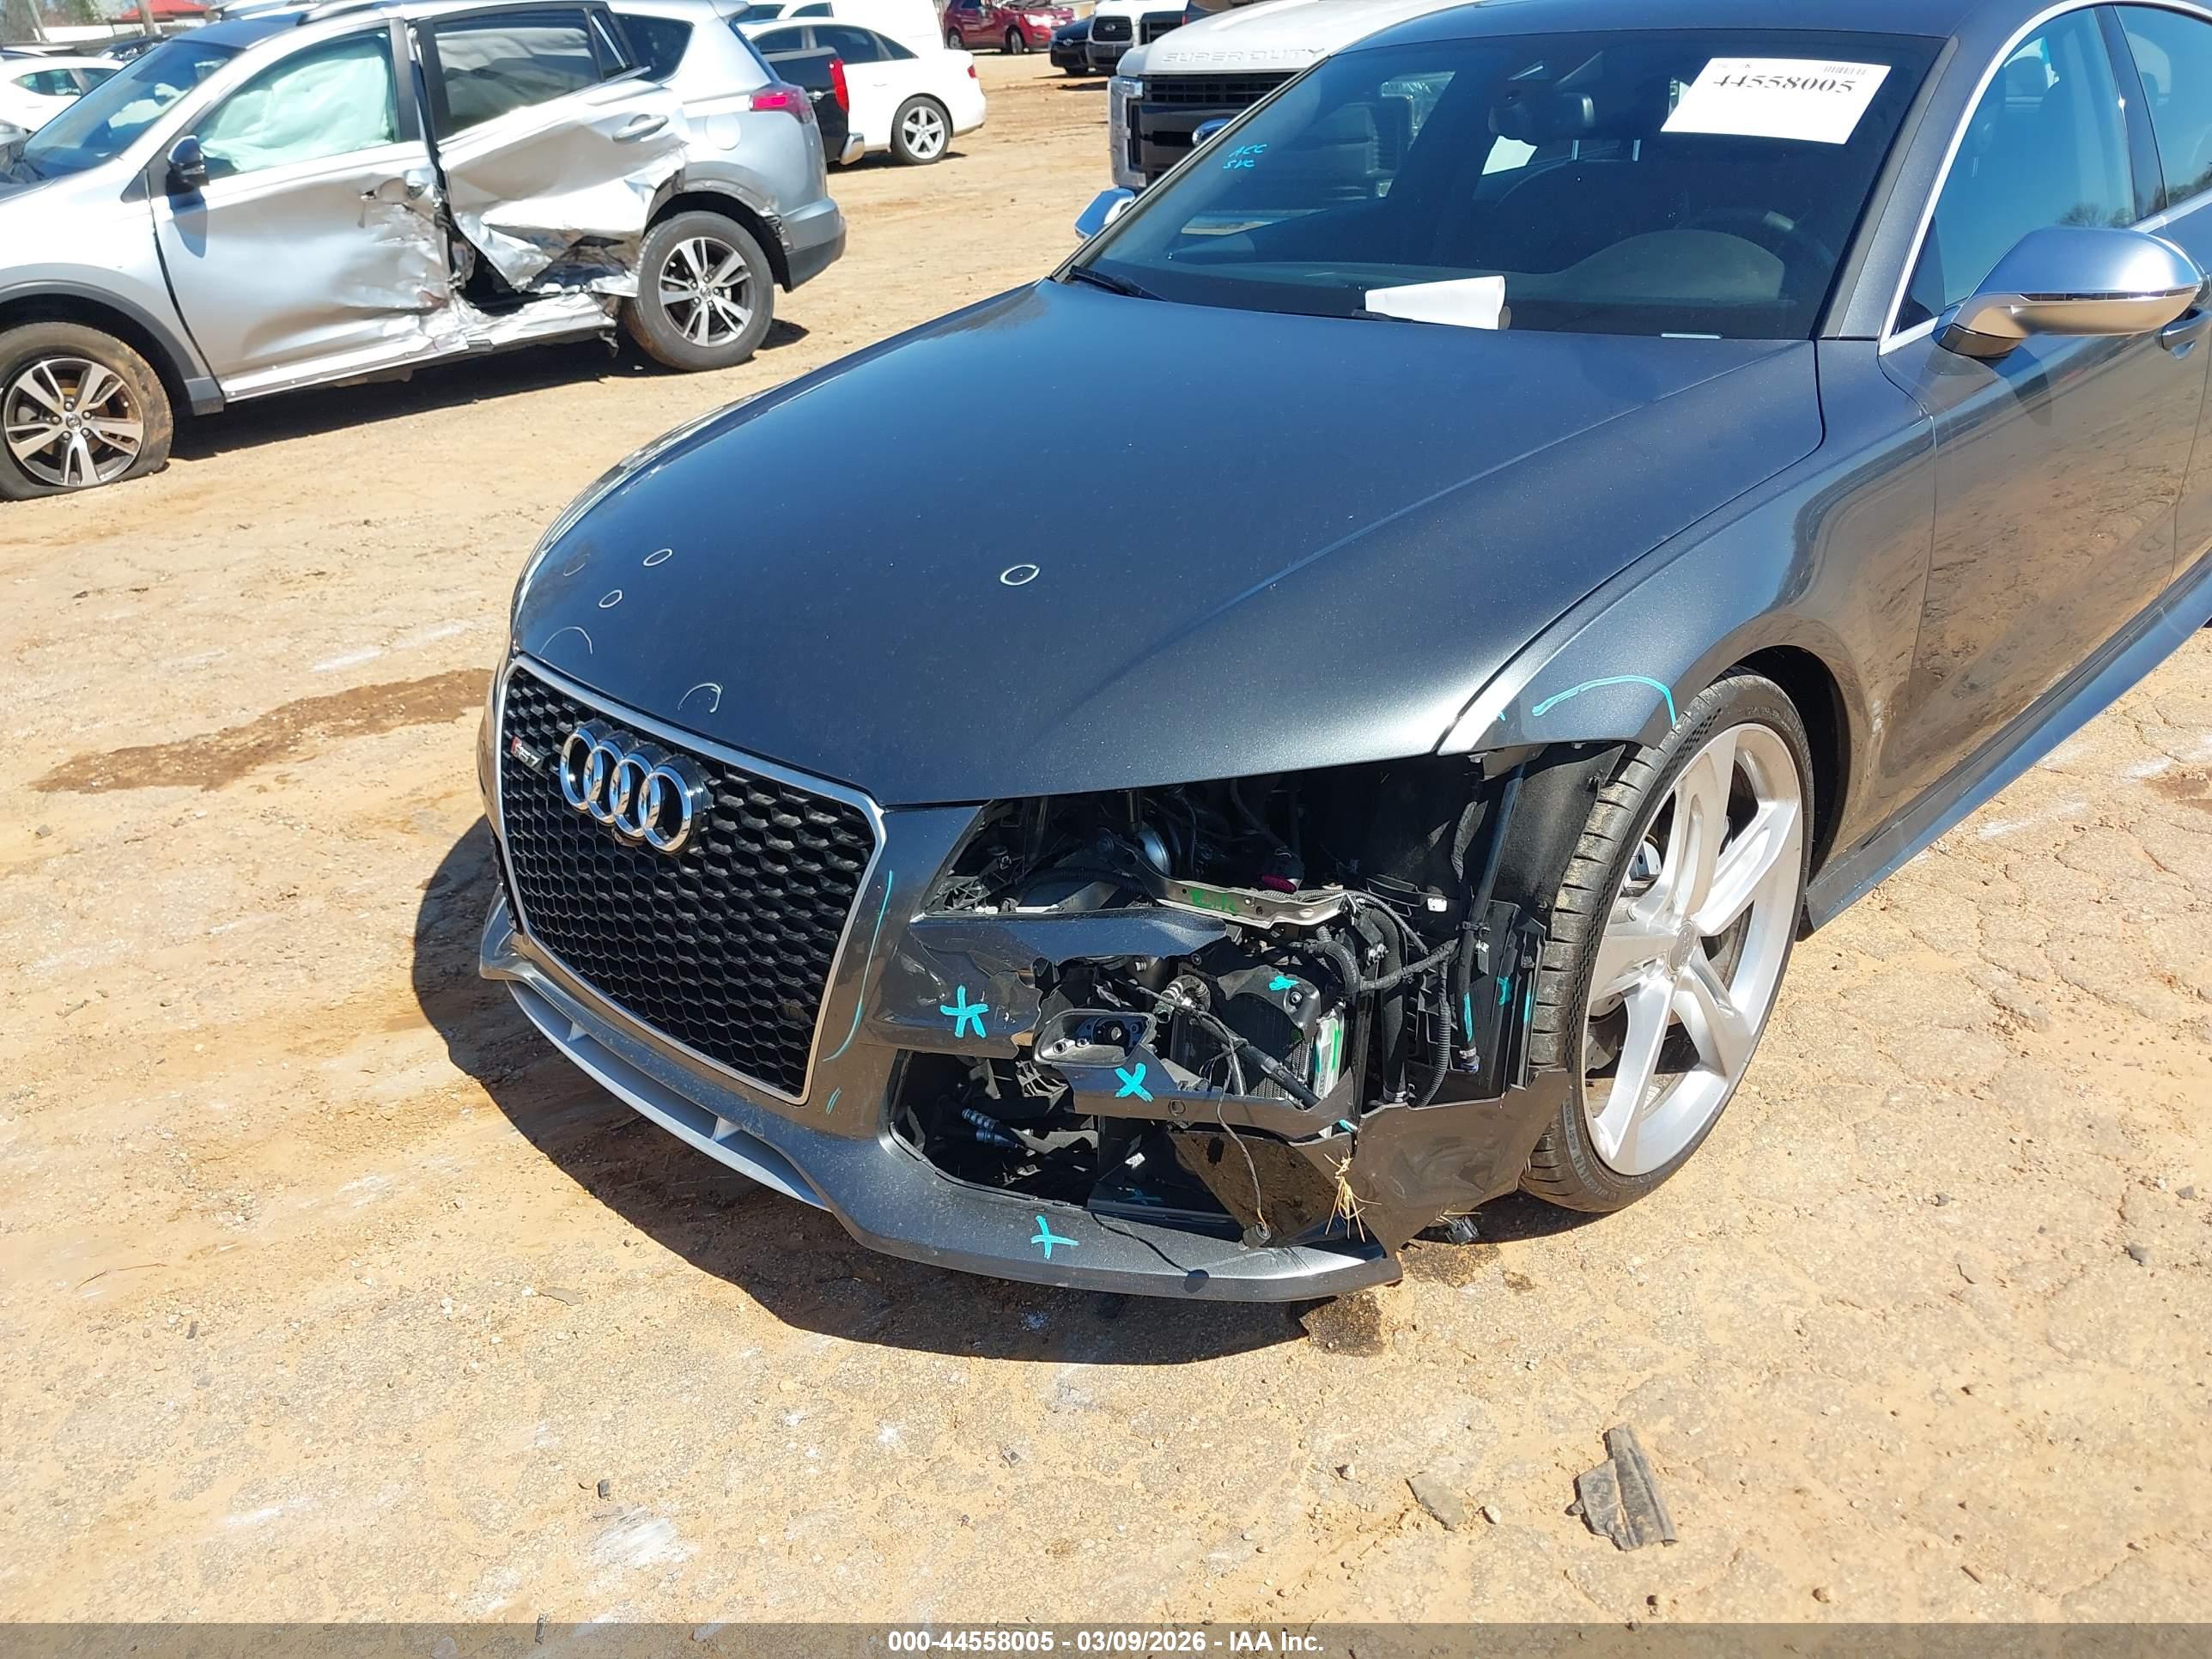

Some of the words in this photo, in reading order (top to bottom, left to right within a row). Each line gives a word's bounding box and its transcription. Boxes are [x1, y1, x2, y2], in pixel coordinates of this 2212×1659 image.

[1162, 51, 1244, 63] SUPER
[1249, 47, 1326, 62] DUTY
[1713, 74, 1856, 94] 44558005
